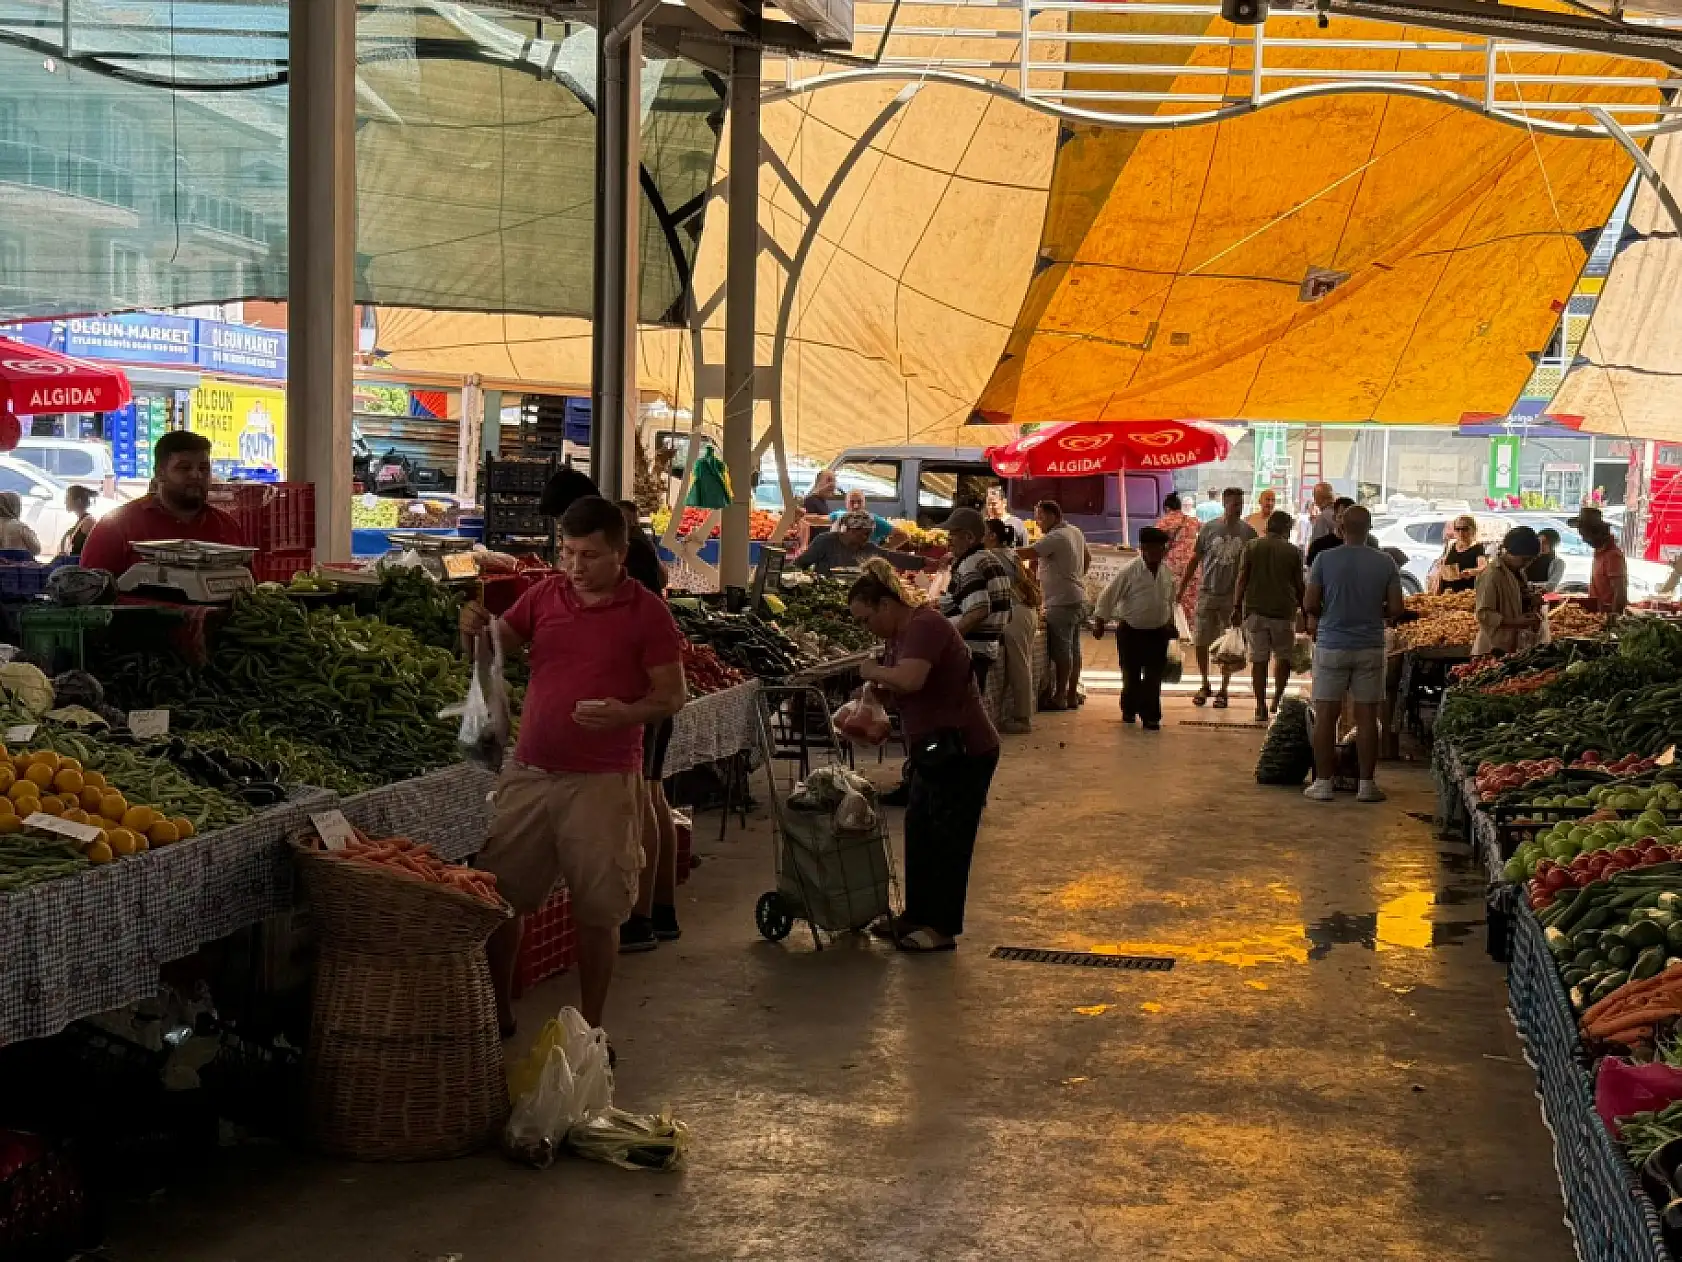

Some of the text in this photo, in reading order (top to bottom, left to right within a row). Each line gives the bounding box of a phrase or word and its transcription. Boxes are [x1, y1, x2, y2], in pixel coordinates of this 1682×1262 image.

[71, 319, 124, 337] OLGUN
[128, 323, 190, 344] MARKET
[212, 328, 243, 352] OLGUN
[244, 332, 278, 357] MARKET
[29, 387, 97, 407] ALGIDA
[196, 387, 234, 412] OLGUN
[196, 411, 233, 432] MARKET
[1047, 458, 1101, 473] ALGIDA
[1141, 451, 1197, 466] ALGIDA
